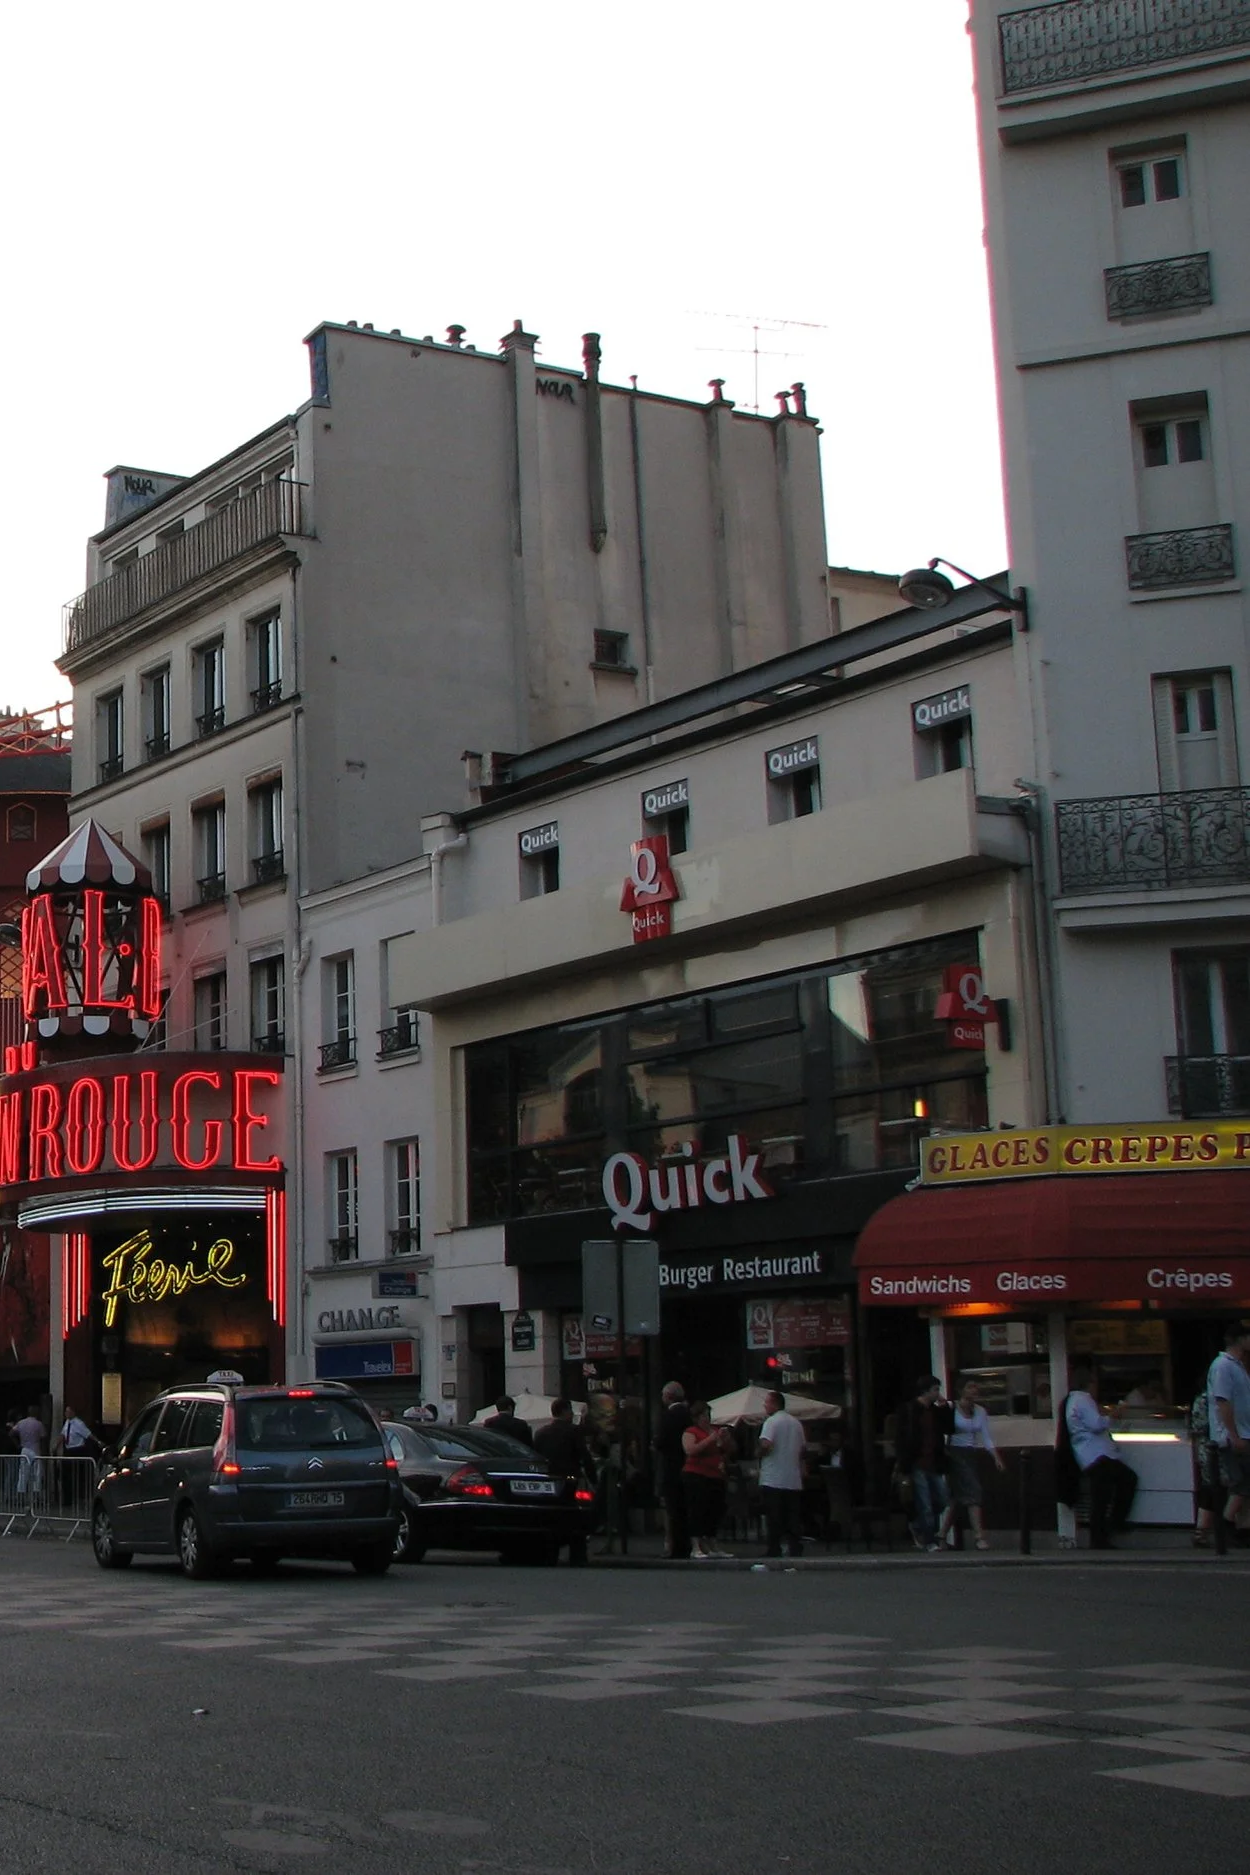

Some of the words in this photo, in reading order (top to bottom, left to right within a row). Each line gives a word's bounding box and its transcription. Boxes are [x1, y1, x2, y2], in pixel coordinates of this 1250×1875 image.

[915, 690, 970, 726] Quick
[770, 742, 818, 774] Quick
[644, 784, 688, 813] Quick
[520, 826, 559, 853] Quick
[633, 848, 662, 898] Q
[632, 911, 665, 932] Quick
[959, 972, 989, 1015] Q
[29, 1069, 280, 1182] ROUGE
[928, 1136, 1050, 1175] GLACES
[1063, 1132, 1219, 1166] CREPES
[603, 1134, 772, 1232] Quick
[102, 1229, 247, 1328] Féerie
[658, 1264, 714, 1290] Burger
[723, 1251, 822, 1282] Restaurant
[869, 1274, 972, 1295] Sandwichs
[996, 1271, 1067, 1291] Glaces
[1146, 1268, 1234, 1292] Crêpes
[317, 1305, 401, 1333] CHANGE
